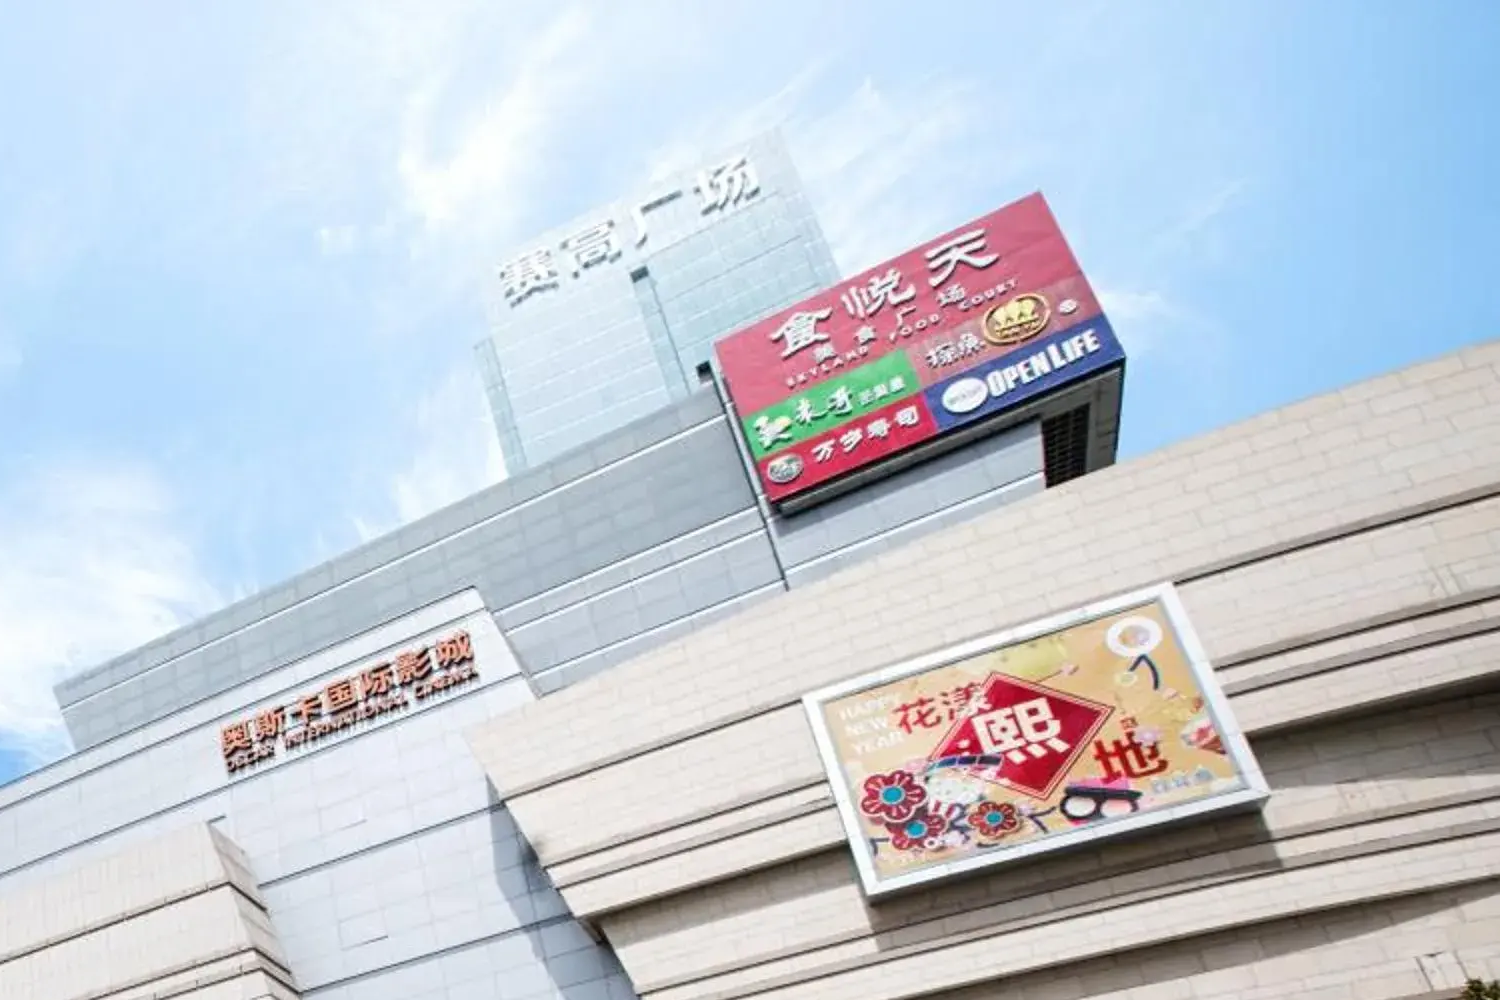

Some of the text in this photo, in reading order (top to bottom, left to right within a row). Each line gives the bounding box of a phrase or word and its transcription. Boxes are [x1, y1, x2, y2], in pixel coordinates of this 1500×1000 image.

[768, 227, 999, 360] 食悦天
[888, 313, 941, 343] FOOD
[220, 628, 476, 760] 奥斯卡国际影城
[956, 696, 1071, 764] 熙
[1092, 732, 1170, 782] 地
